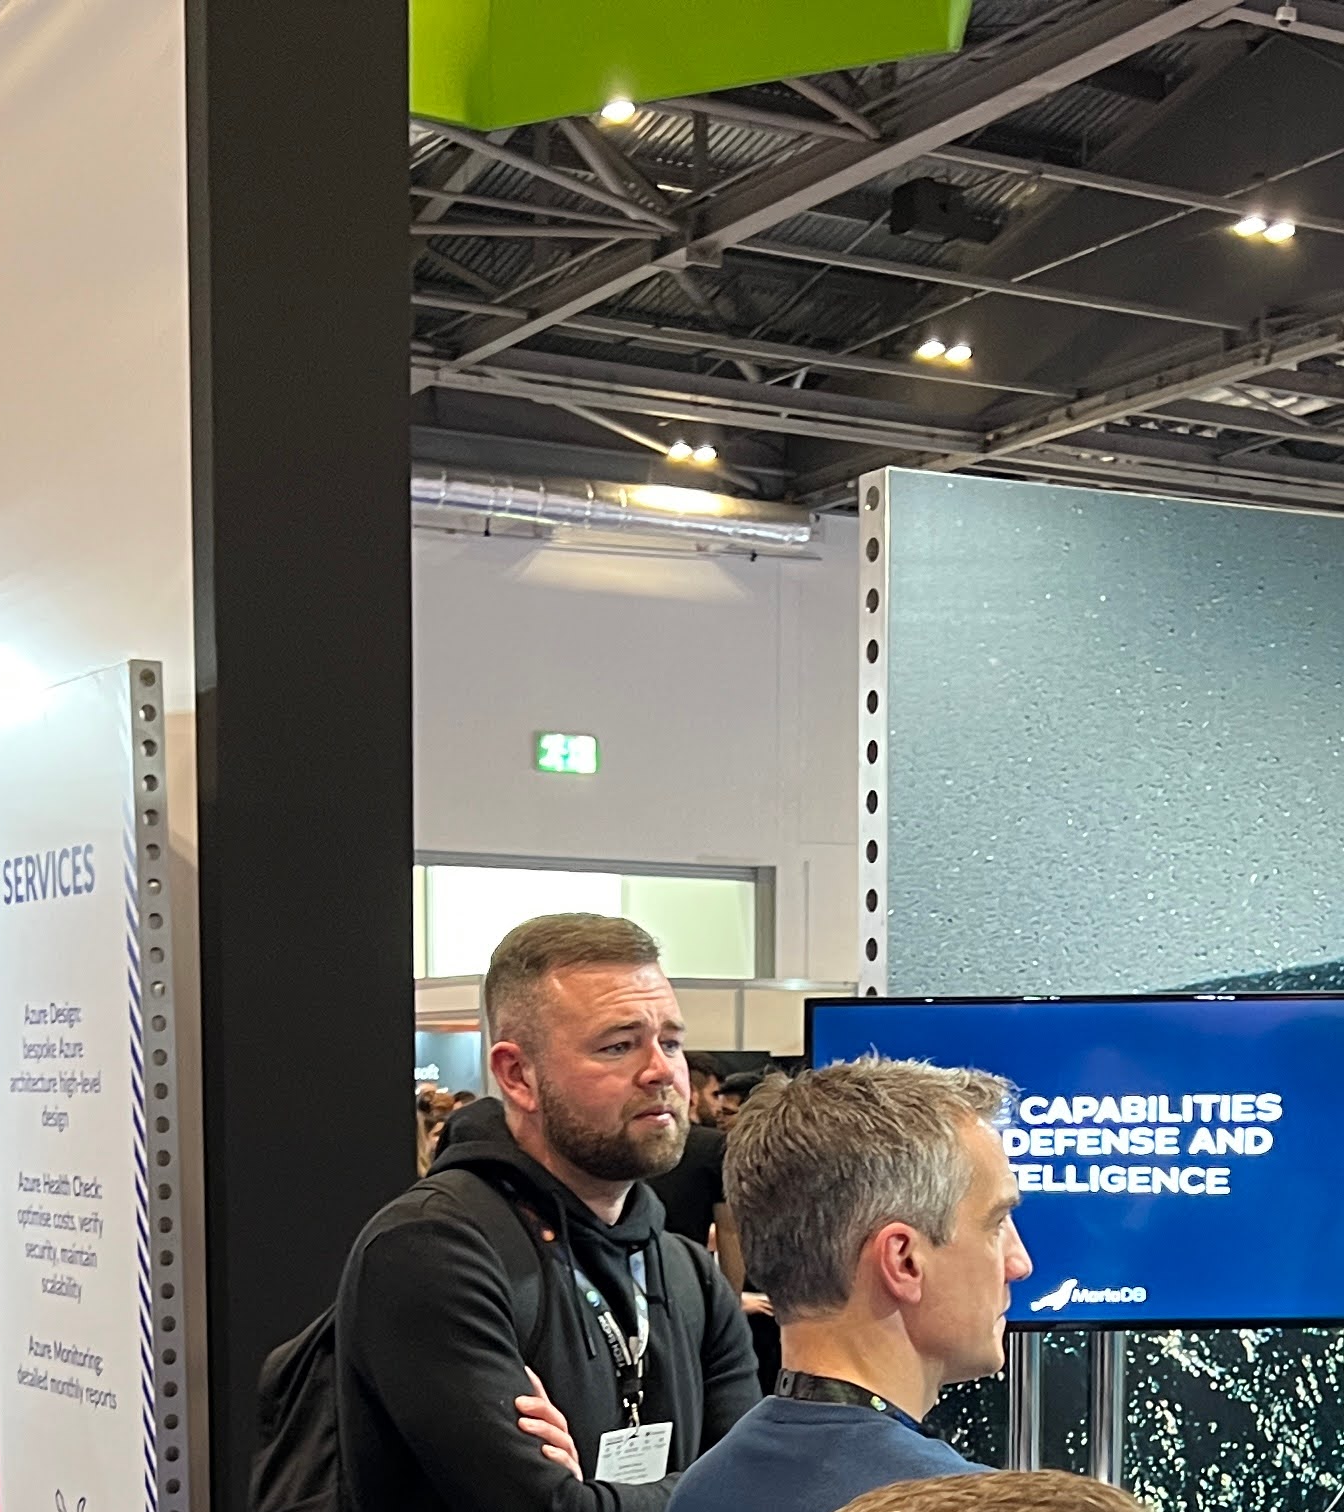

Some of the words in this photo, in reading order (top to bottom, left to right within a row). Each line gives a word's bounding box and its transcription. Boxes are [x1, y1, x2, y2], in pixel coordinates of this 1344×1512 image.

[3, 843, 96, 905] SERVICES
[24, 1004, 48, 1025] Azure
[23, 1037, 56, 1061] bespoke
[59, 1037, 83, 1058] Azure
[10, 1071, 57, 1094] architecture
[59, 1070, 102, 1098] high-level
[42, 1105, 69, 1132] design
[1019, 1093, 1283, 1126] CAPABILITIES
[1003, 1127, 1180, 1156] DEFENSE
[1189, 1127, 1273, 1155] AND
[18, 1171, 41, 1193] Azure
[43, 1173, 71, 1196] Health
[1008, 1164, 1231, 1195] ELLIGENCE
[18, 1206, 51, 1228] optimise
[79, 1211, 104, 1239] verify
[60, 1242, 97, 1267] maintain
[42, 1275, 82, 1304] scalability
[1072, 1287, 1146, 1303] MariaDB
[29, 1335, 52, 1360] Azure
[17, 1363, 48, 1391] detailed
[50, 1375, 84, 1406] monthly
[86, 1386, 117, 1410] reports
